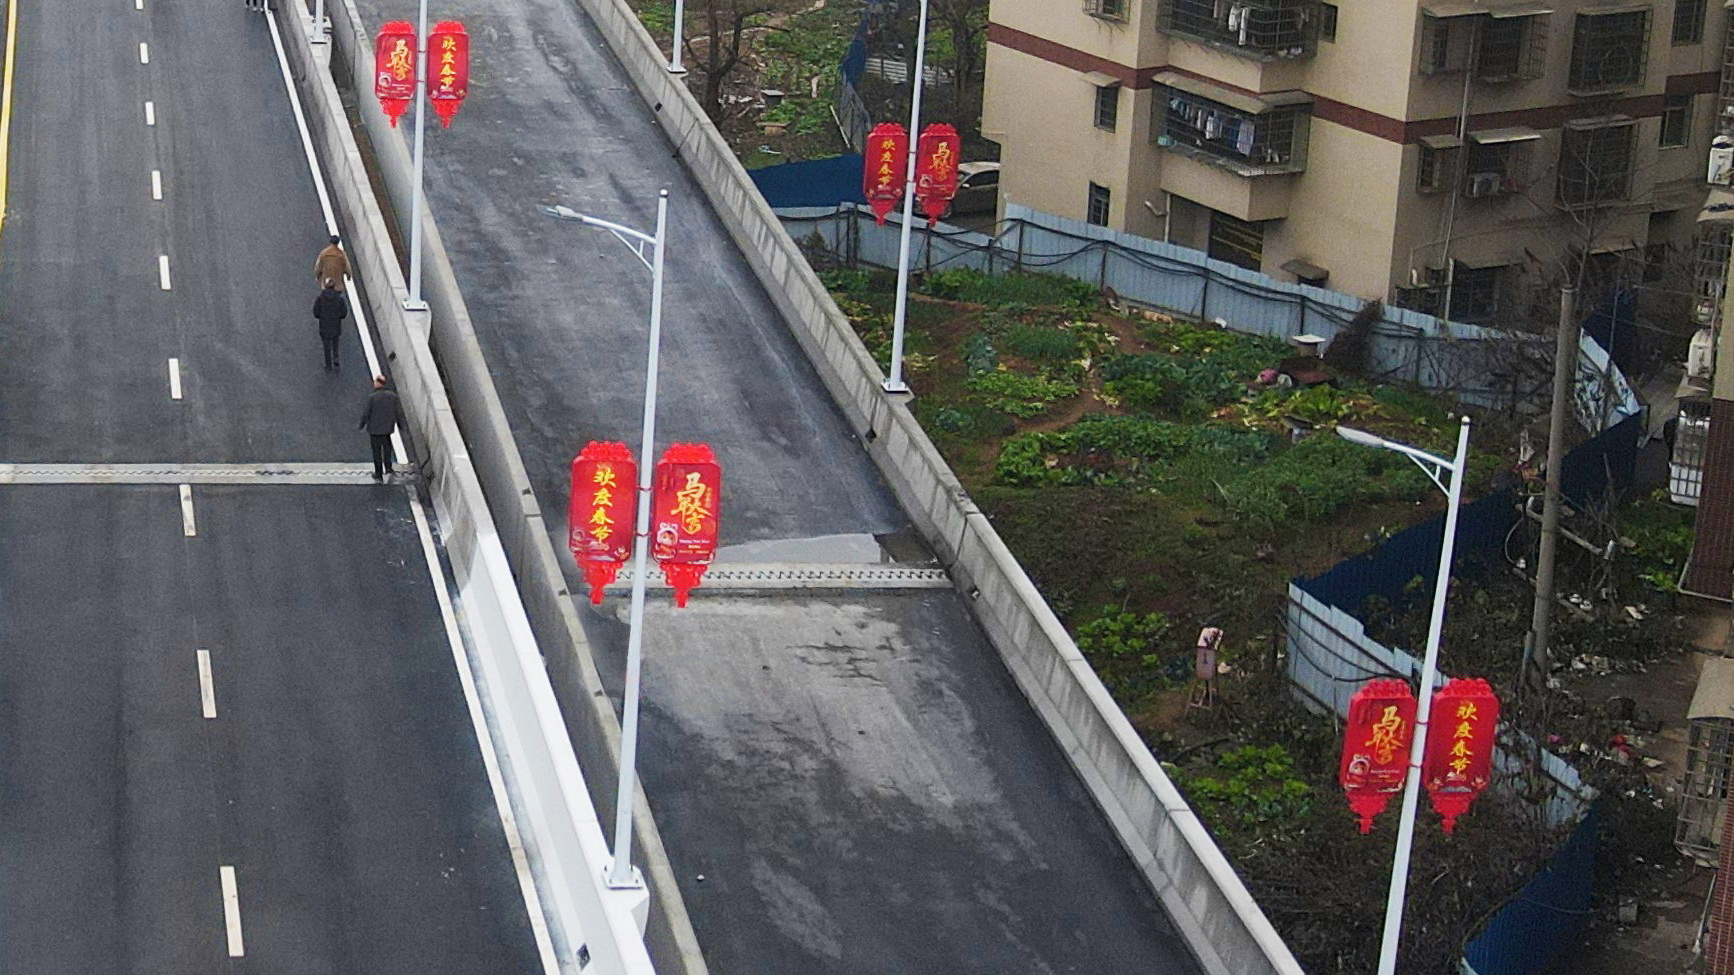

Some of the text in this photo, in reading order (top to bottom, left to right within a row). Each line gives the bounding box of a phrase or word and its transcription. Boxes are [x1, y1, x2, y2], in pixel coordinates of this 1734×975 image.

[878, 139, 896, 185] 欢度春节
[589, 466, 617, 544] 欢度春节
[1449, 703, 1478, 775] 欢度春节
